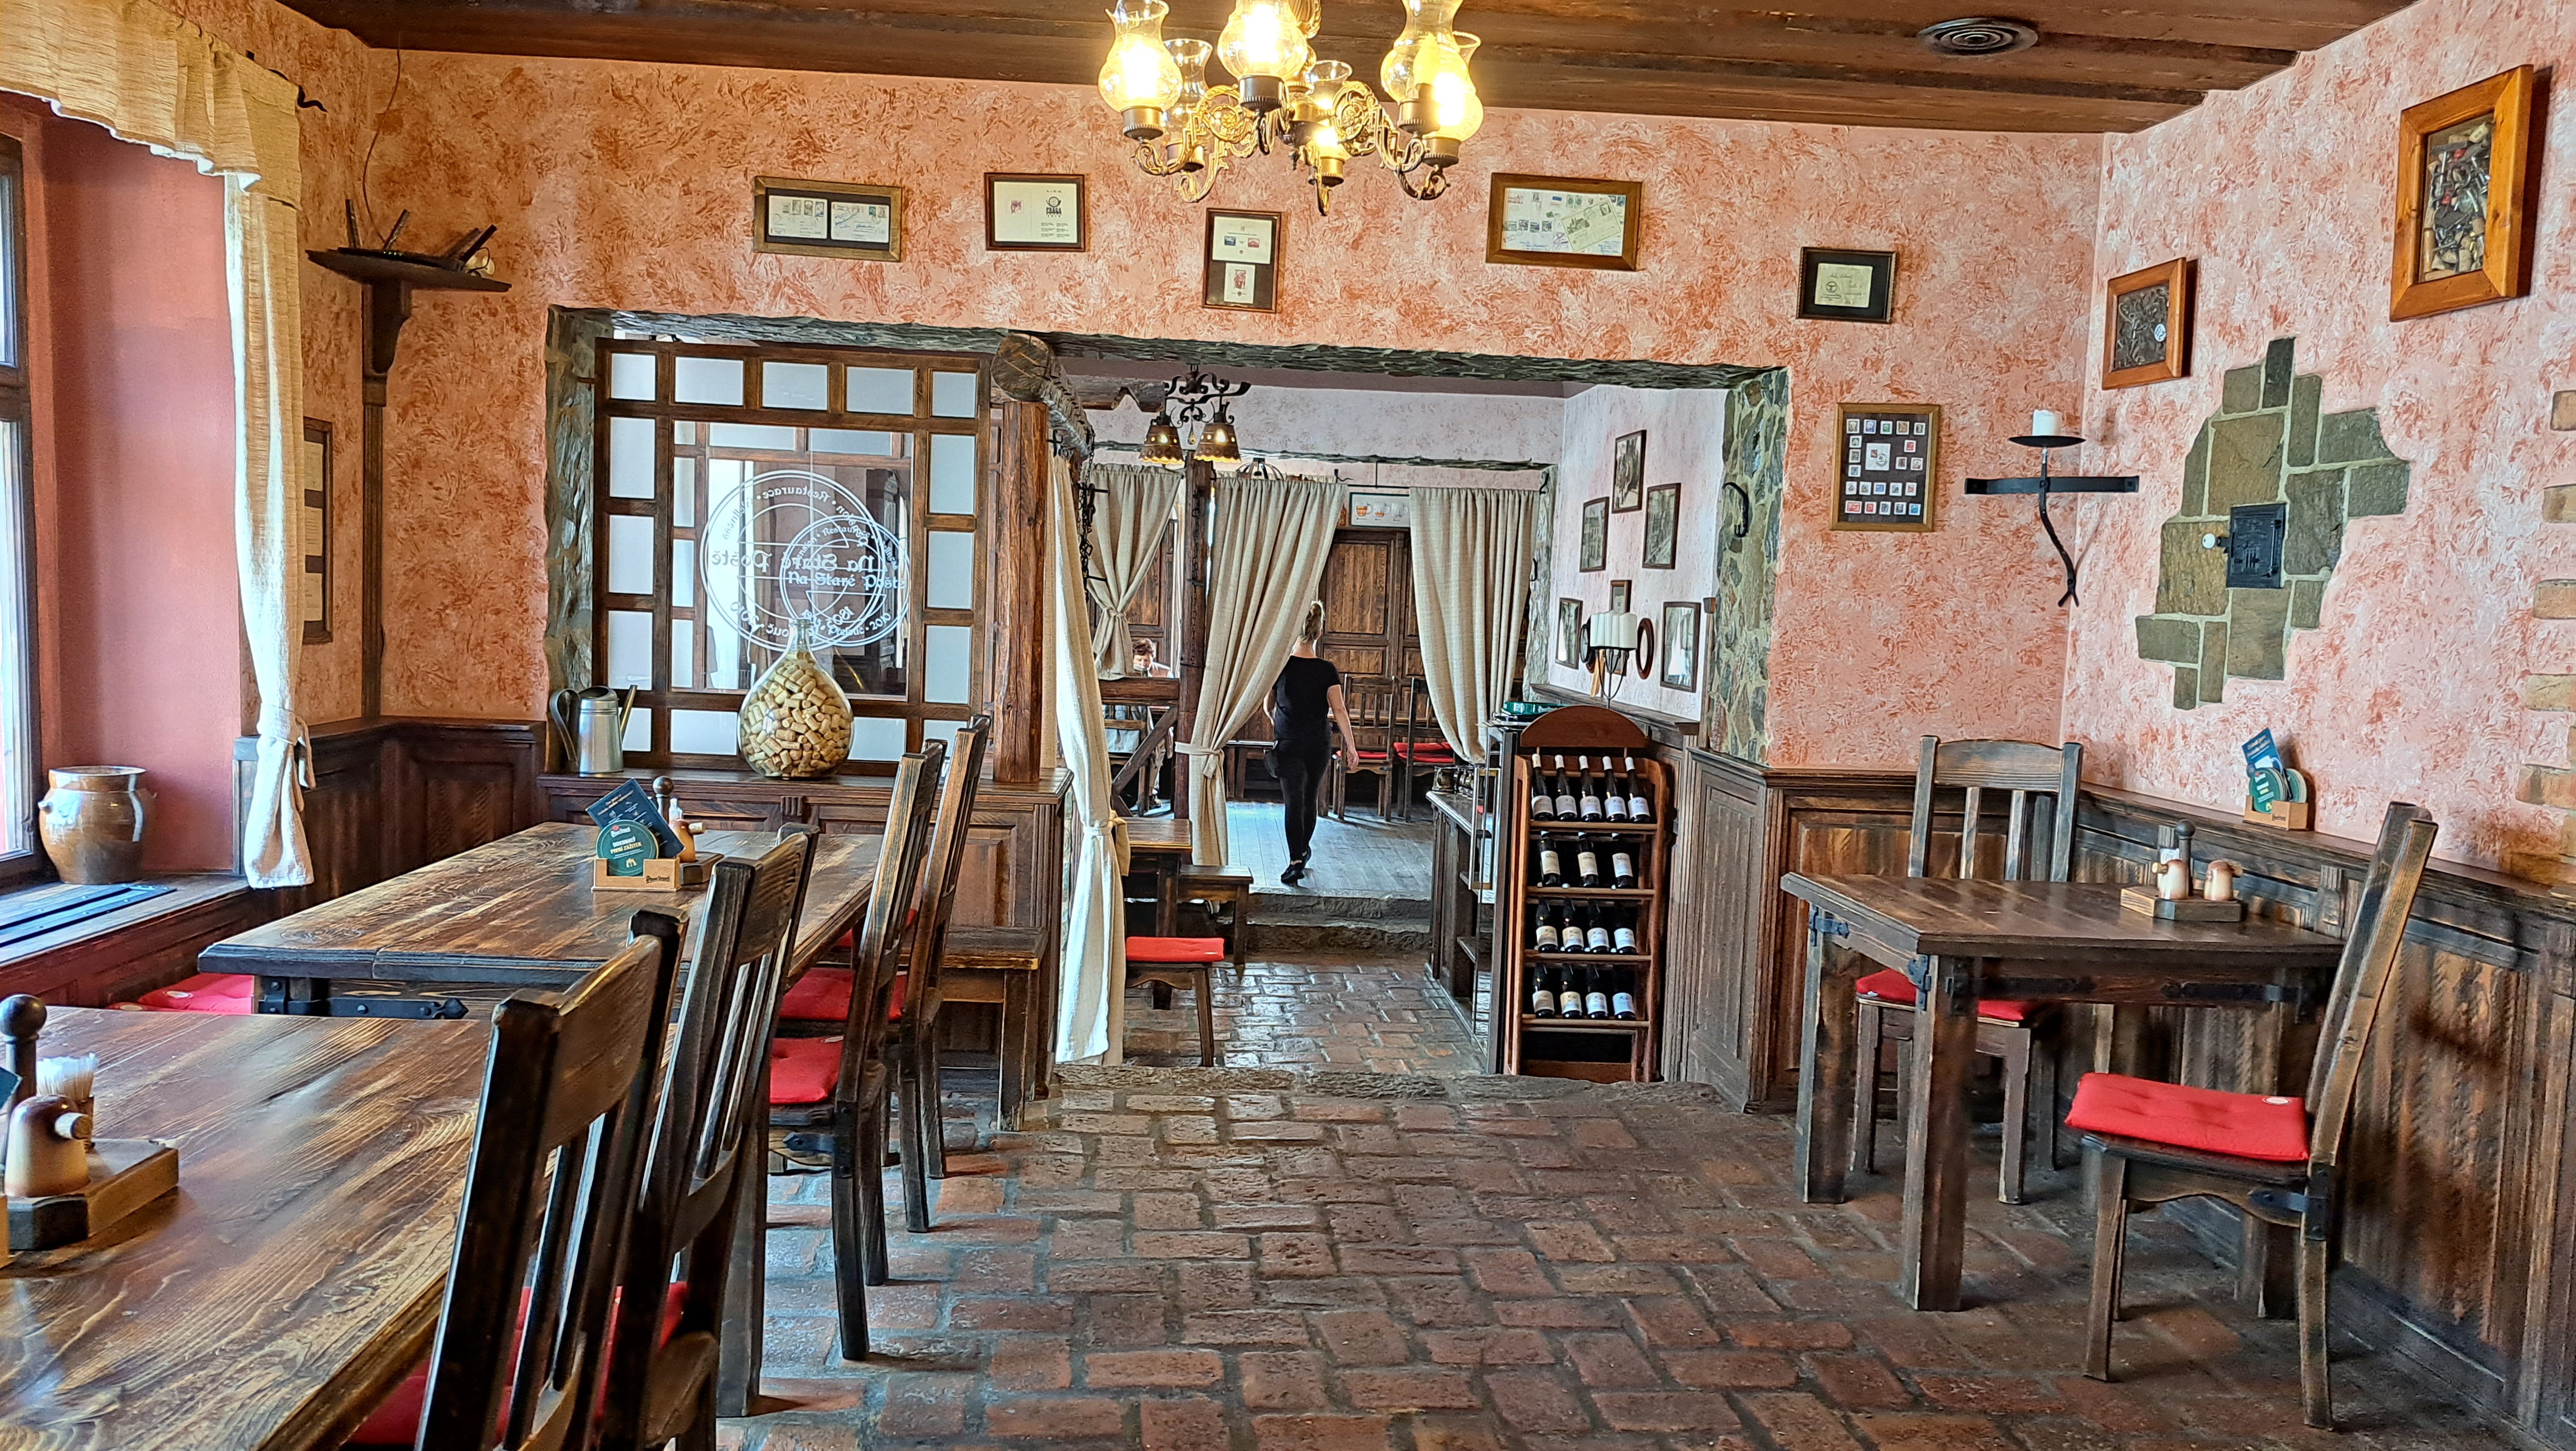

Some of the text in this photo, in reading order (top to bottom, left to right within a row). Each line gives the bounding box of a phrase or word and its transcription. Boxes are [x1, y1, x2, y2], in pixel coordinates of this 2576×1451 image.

[796, 537, 818, 561] ension
[822, 526, 871, 539] Restaurace
[788, 571, 906, 591] Na Staré Poště
[869, 612, 891, 631] 2010
